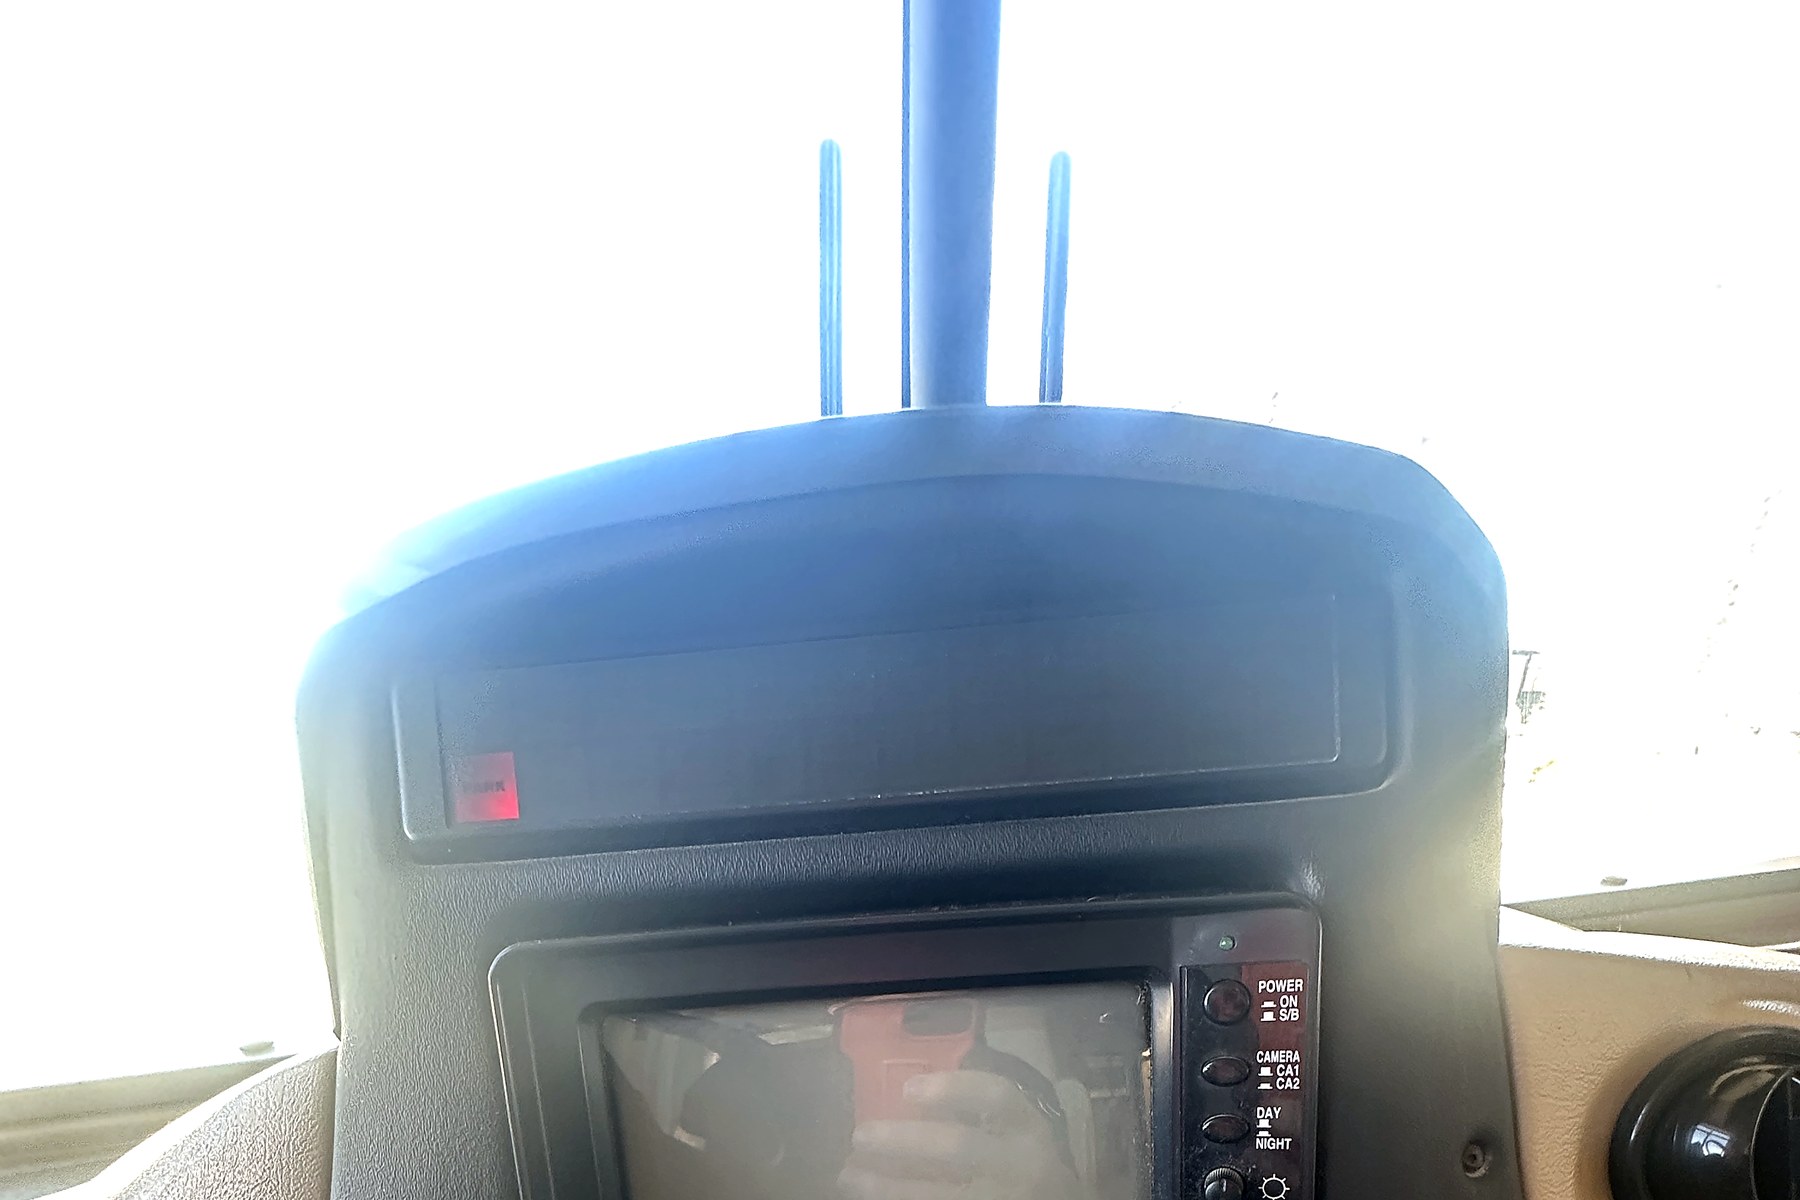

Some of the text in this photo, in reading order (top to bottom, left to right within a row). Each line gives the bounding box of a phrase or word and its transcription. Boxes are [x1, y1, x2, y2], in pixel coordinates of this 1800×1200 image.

[1258, 979, 1304, 993] POWER
[1279, 995, 1298, 1008] ON
[1279, 1009, 1300, 1021] S/B
[1256, 1050, 1300, 1063] CAMERA
[1276, 1064, 1299, 1077] CA1
[1276, 1077, 1300, 1090] CA2
[1256, 1106, 1282, 1119] DAY
[1255, 1138, 1292, 1150] NIGHT
